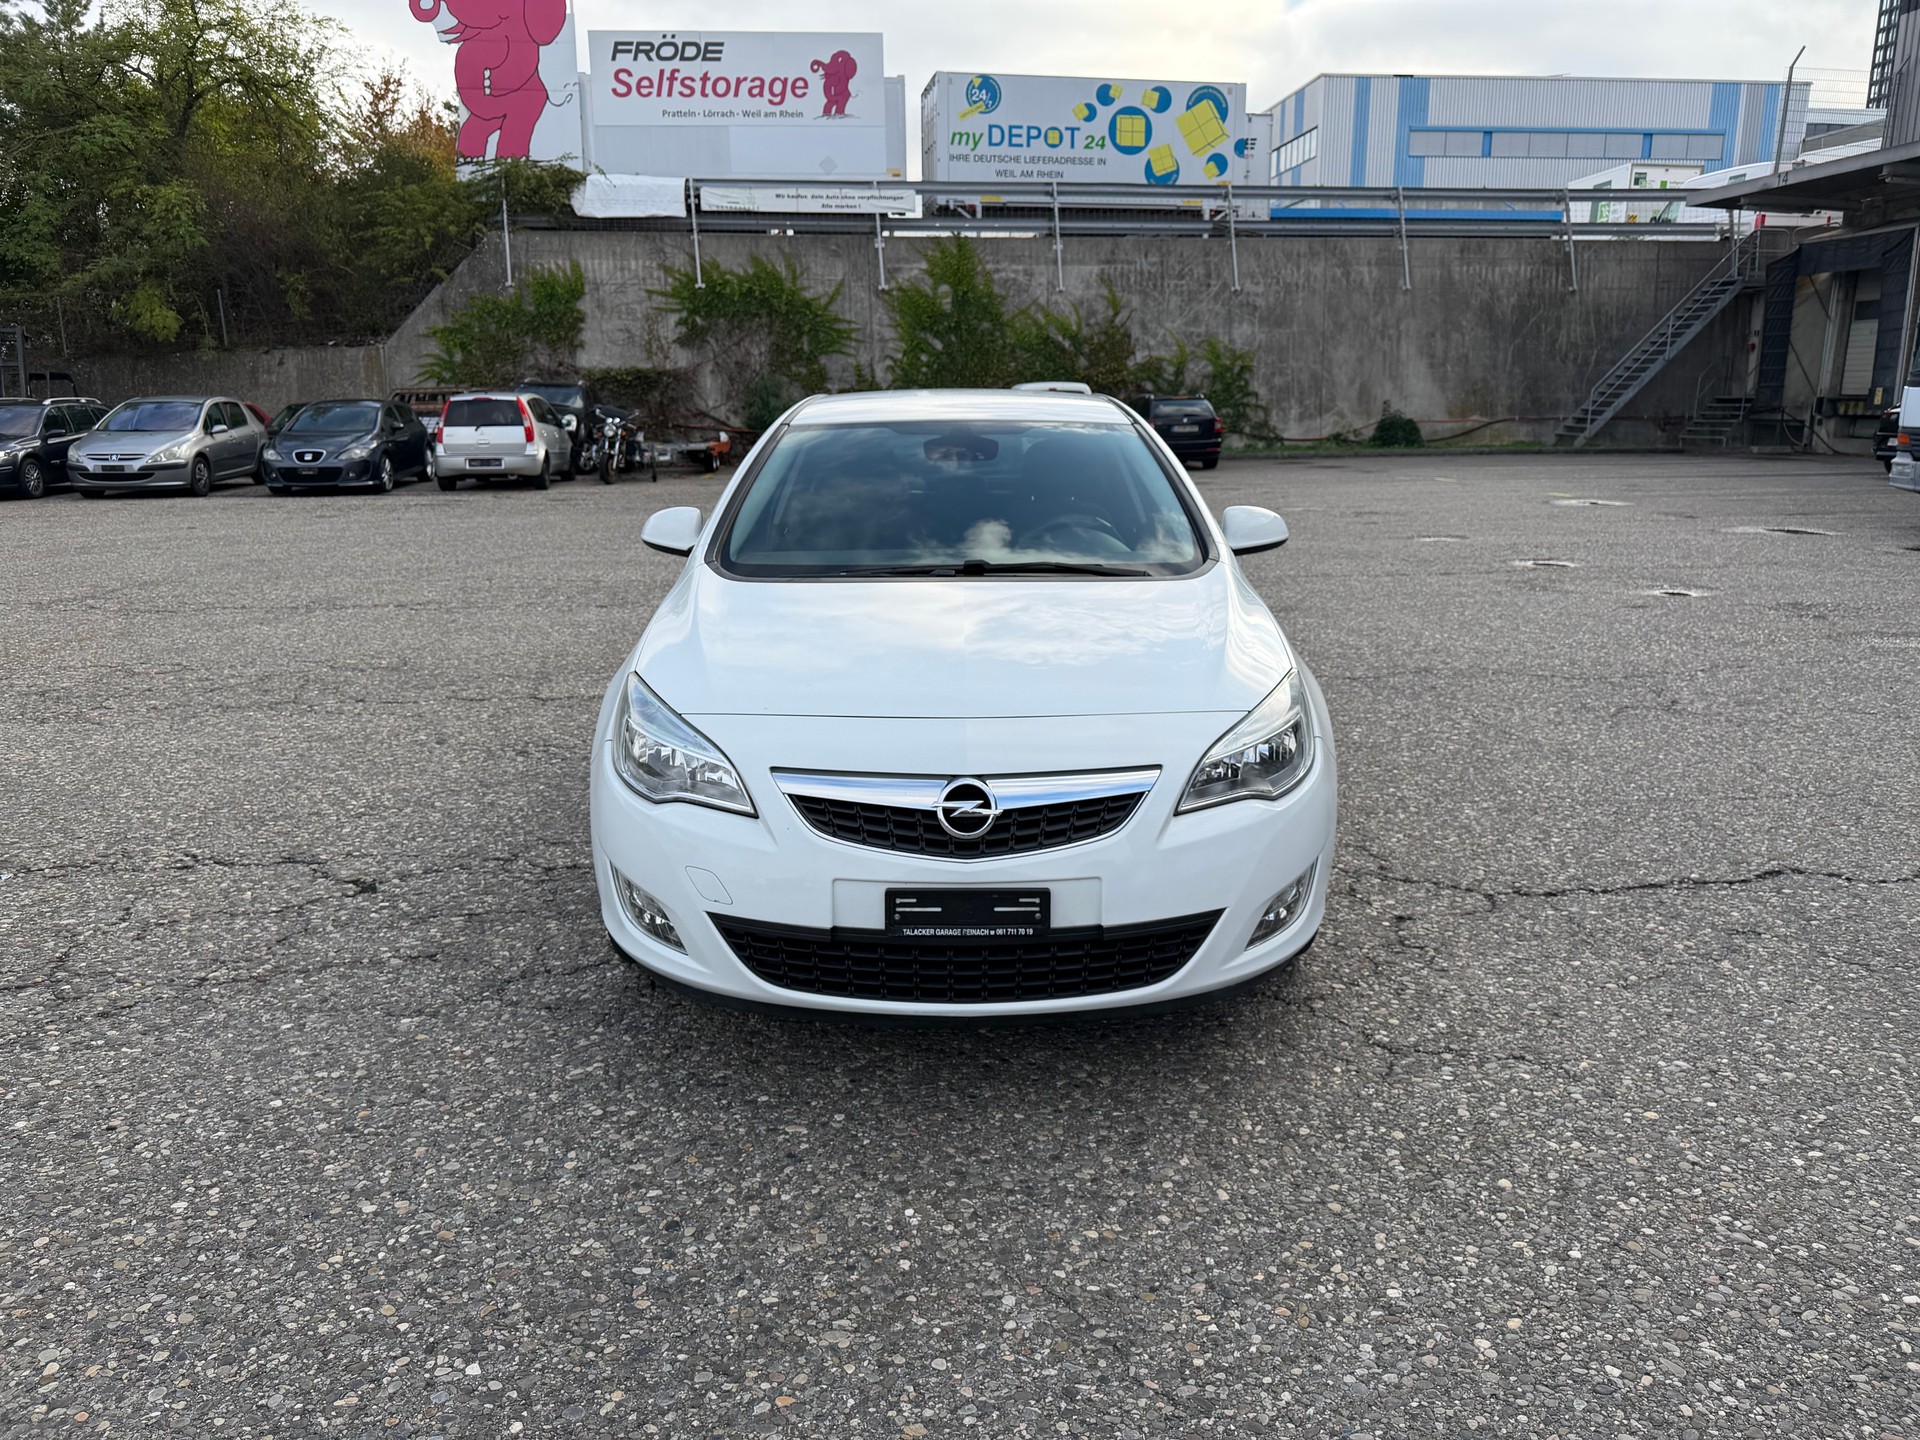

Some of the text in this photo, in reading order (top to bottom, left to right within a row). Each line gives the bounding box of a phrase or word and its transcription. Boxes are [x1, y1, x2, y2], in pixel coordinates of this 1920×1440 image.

[611, 34, 724, 61] FRÖDE
[611, 68, 808, 106] Selfstorage
[662, 109, 696, 118] Pratteln
[703, 109, 735, 118] Lörrach
[742, 110, 761, 118] Weil
[779, 110, 803, 118] Rhein
[950, 124, 1106, 151] my DEPOT 24
[949, 154, 1106, 166] IHRE DEUTSCHE LIEFERADRESSE IN
[995, 169, 1064, 178] WEIL AM RHEIN
[1778, 172, 1788, 186] 14
